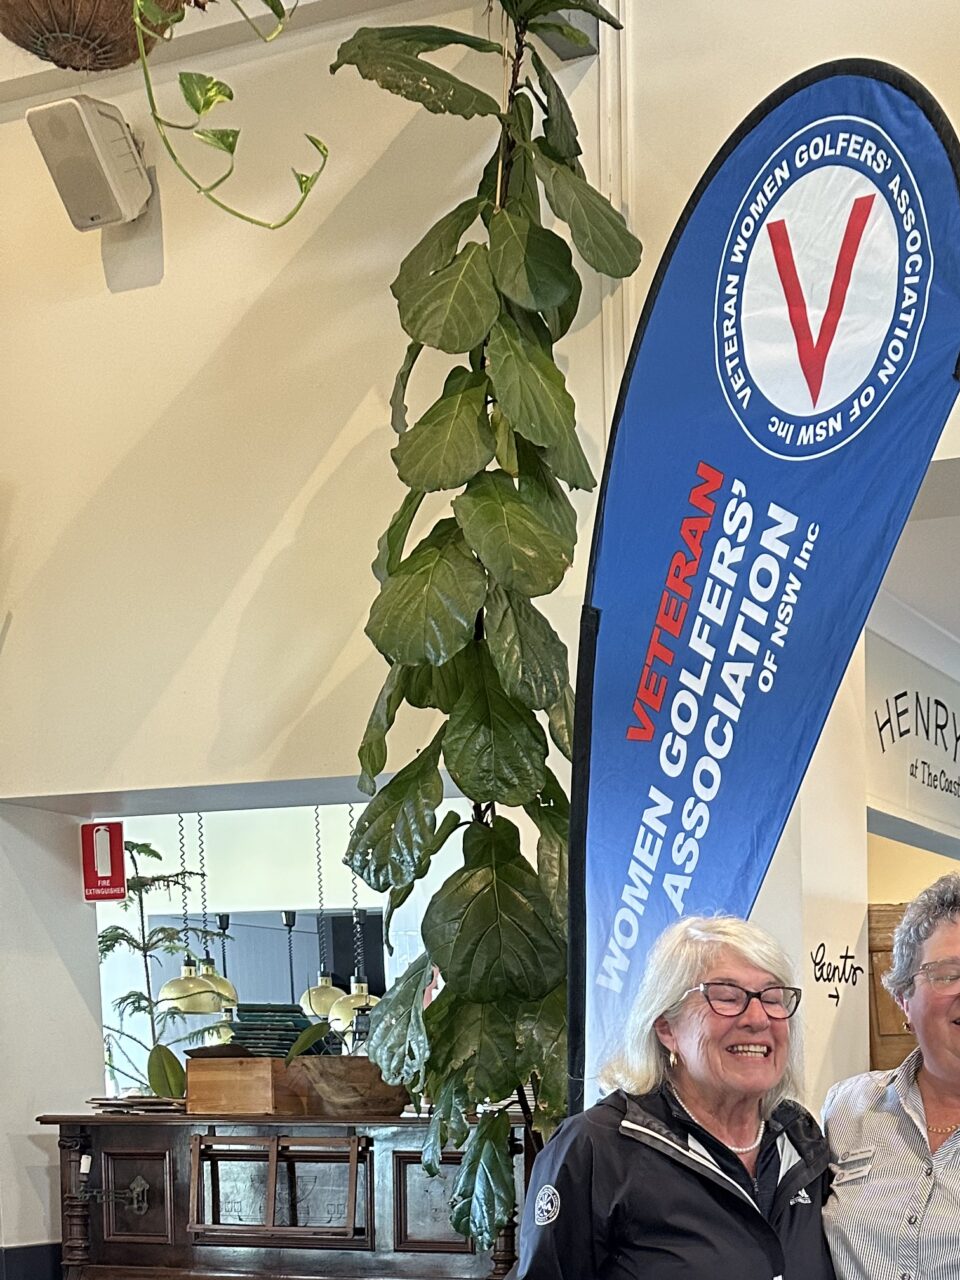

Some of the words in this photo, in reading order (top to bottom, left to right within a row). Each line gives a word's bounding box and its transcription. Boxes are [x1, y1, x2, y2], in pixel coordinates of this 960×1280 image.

[730, 160, 790, 264] WOMEN
[766, 193, 876, 410] V
[878, 174, 923, 386] ASSOCIATION
[723, 274, 753, 409] VETERAN
[768, 416, 794, 444] Inc
[797, 415, 843, 446] NSW
[849, 387, 876, 421] OF
[626, 461, 725, 742] VETERAN
[758, 650, 779, 693] OF
[770, 572, 803, 648] NSW
[793, 523, 820, 571] Inc
[597, 785, 675, 994] WOMEN
[659, 478, 754, 778] GOLFERS'
[661, 502, 800, 916] ASSOCIATION
[909, 758, 919, 779] at
[921, 760, 939, 790] The
[939, 769, 960, 798] Coast
[85, 886, 125, 896] EXTINGUISHER
[97, 879, 111, 887] FIRE
[810, 942, 864, 986] Gents
